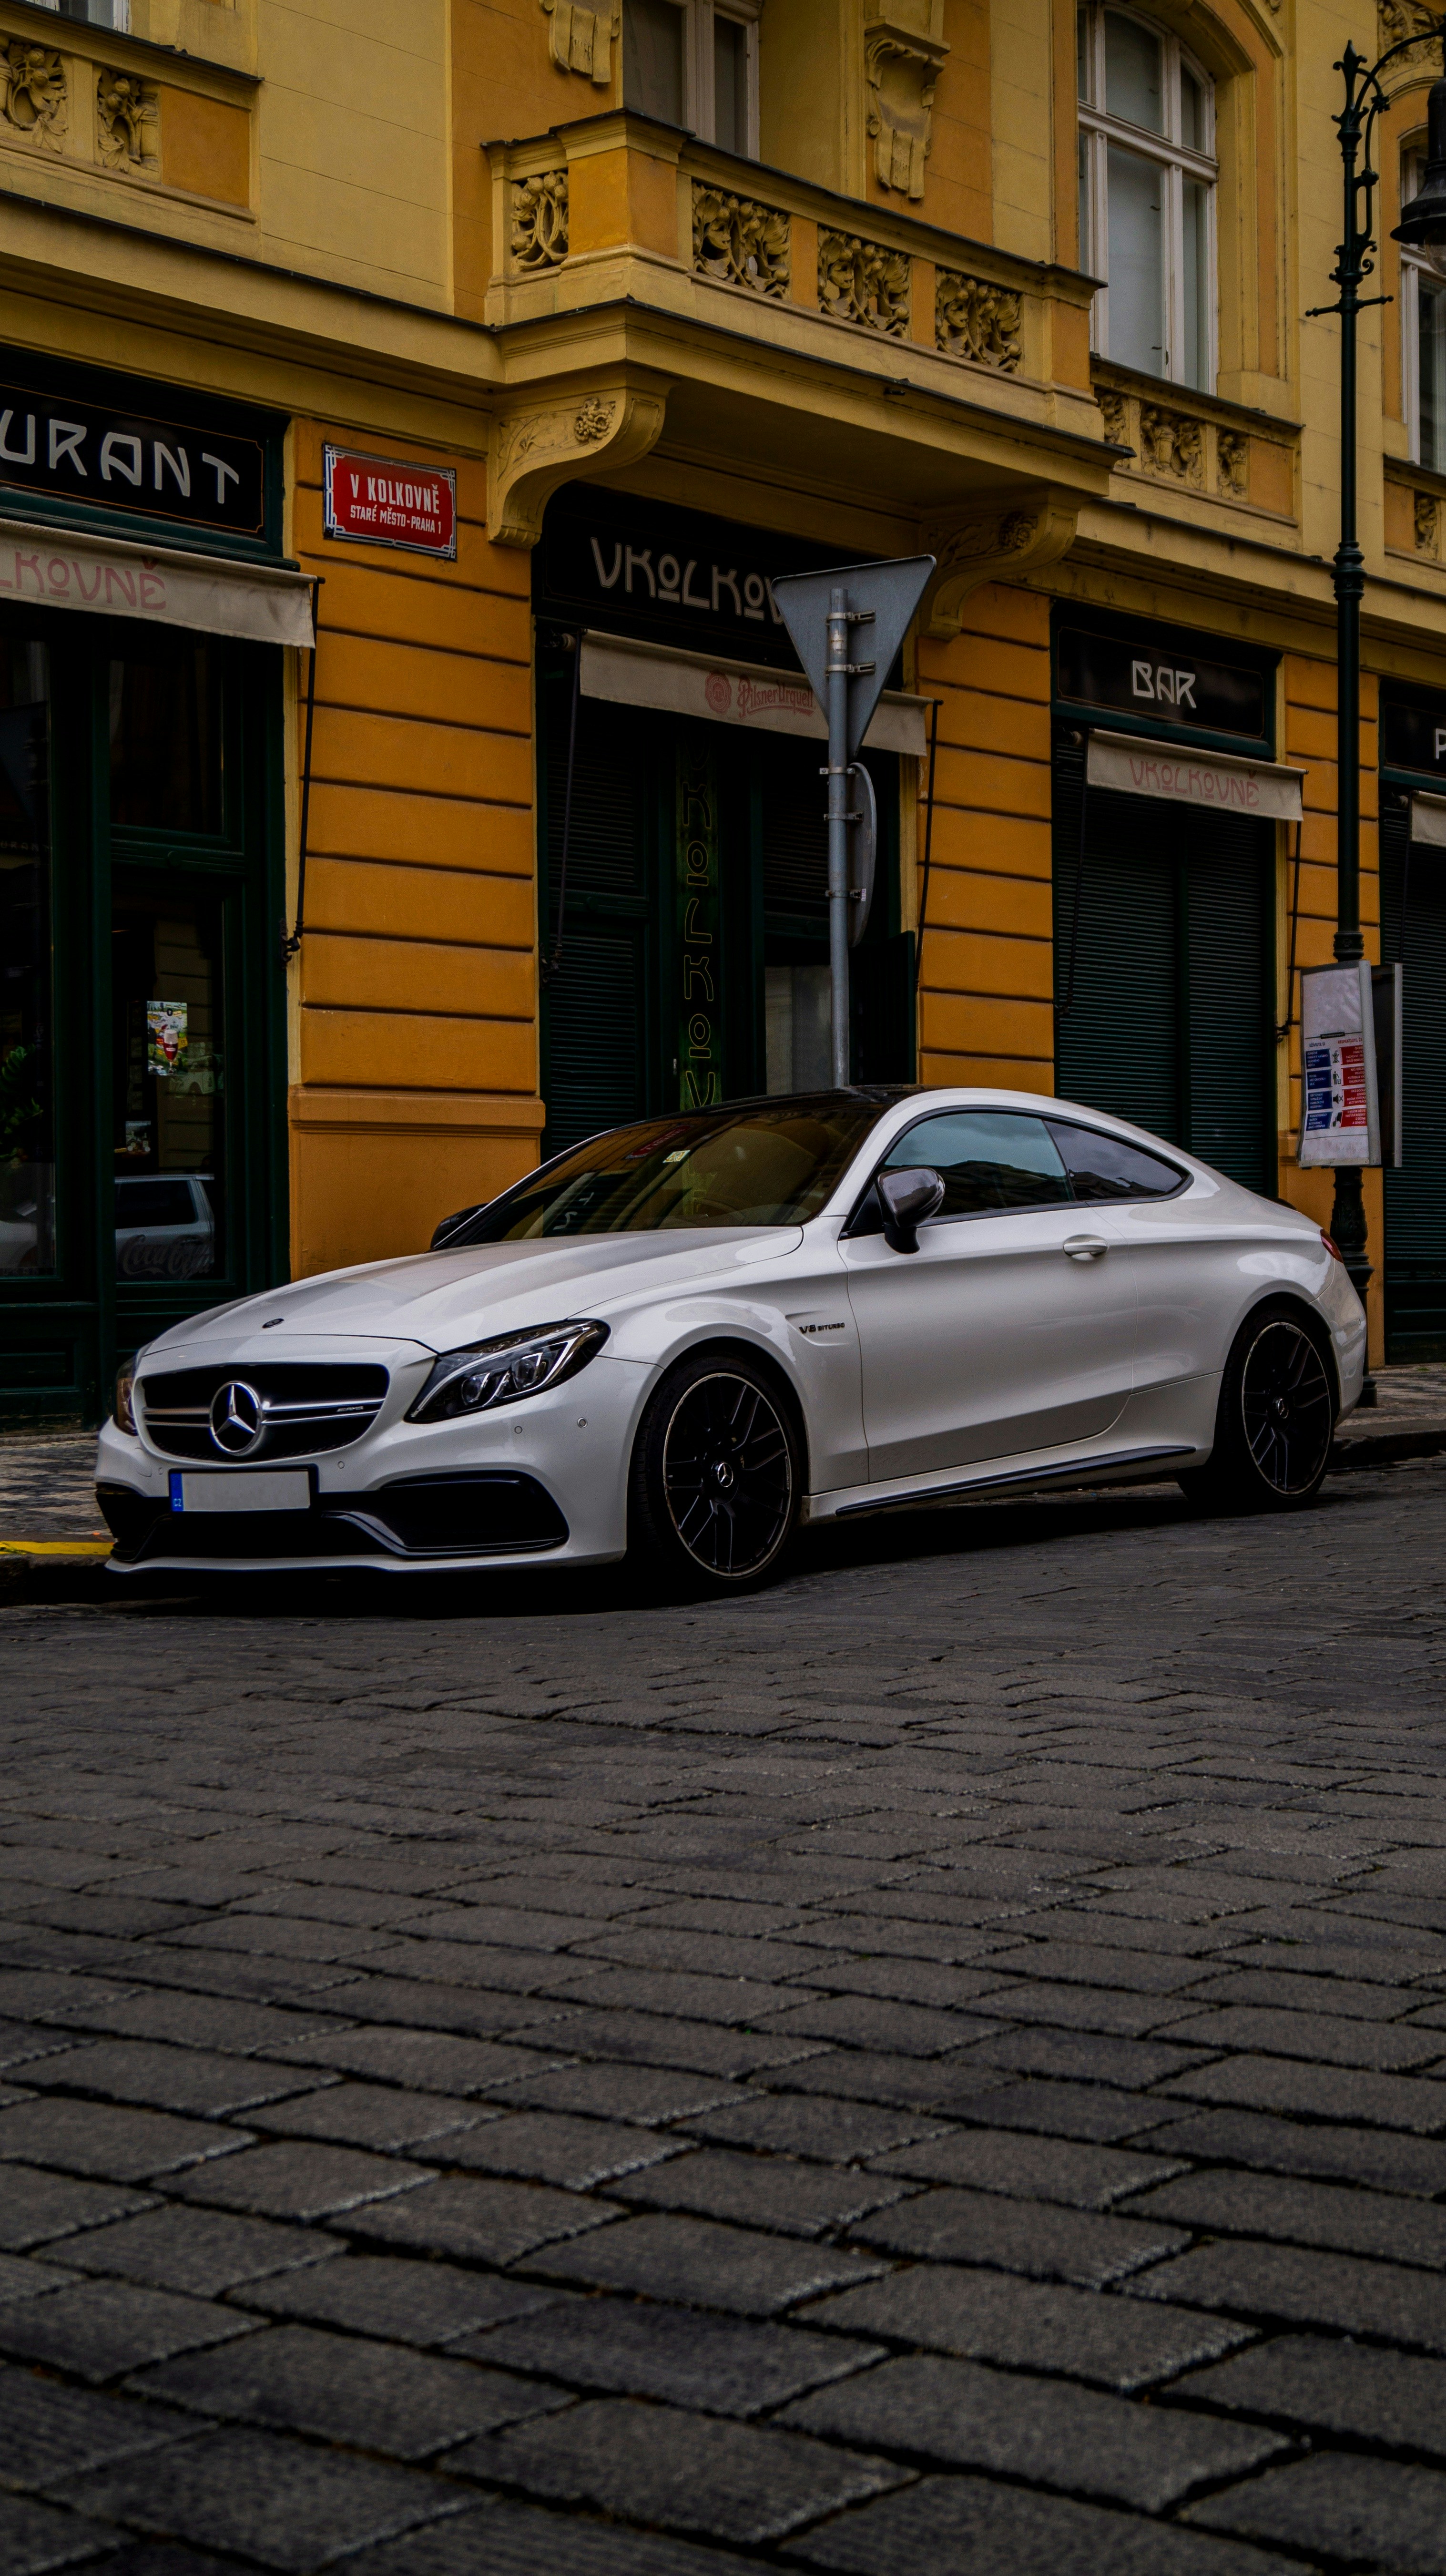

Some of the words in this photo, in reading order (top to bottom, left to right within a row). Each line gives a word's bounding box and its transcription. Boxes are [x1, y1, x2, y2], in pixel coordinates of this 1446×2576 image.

[0, 409, 239, 504] URANT
[350, 473, 359, 498] V
[367, 477, 440, 514] KOLKOVNĚ
[350, 504, 377, 522] STARÉ
[438, 521, 441, 534] 1
[737, 674, 779, 719] Pilsner
[776, 679, 813, 715] Urquell
[1131, 660, 1197, 709] BAR
[1129, 758, 1259, 807] VKOLKOVNĚ
[799, 1325, 816, 1334] V8
[817, 1322, 845, 1331] BITURBO
[173, 1498, 182, 1507] CZ
